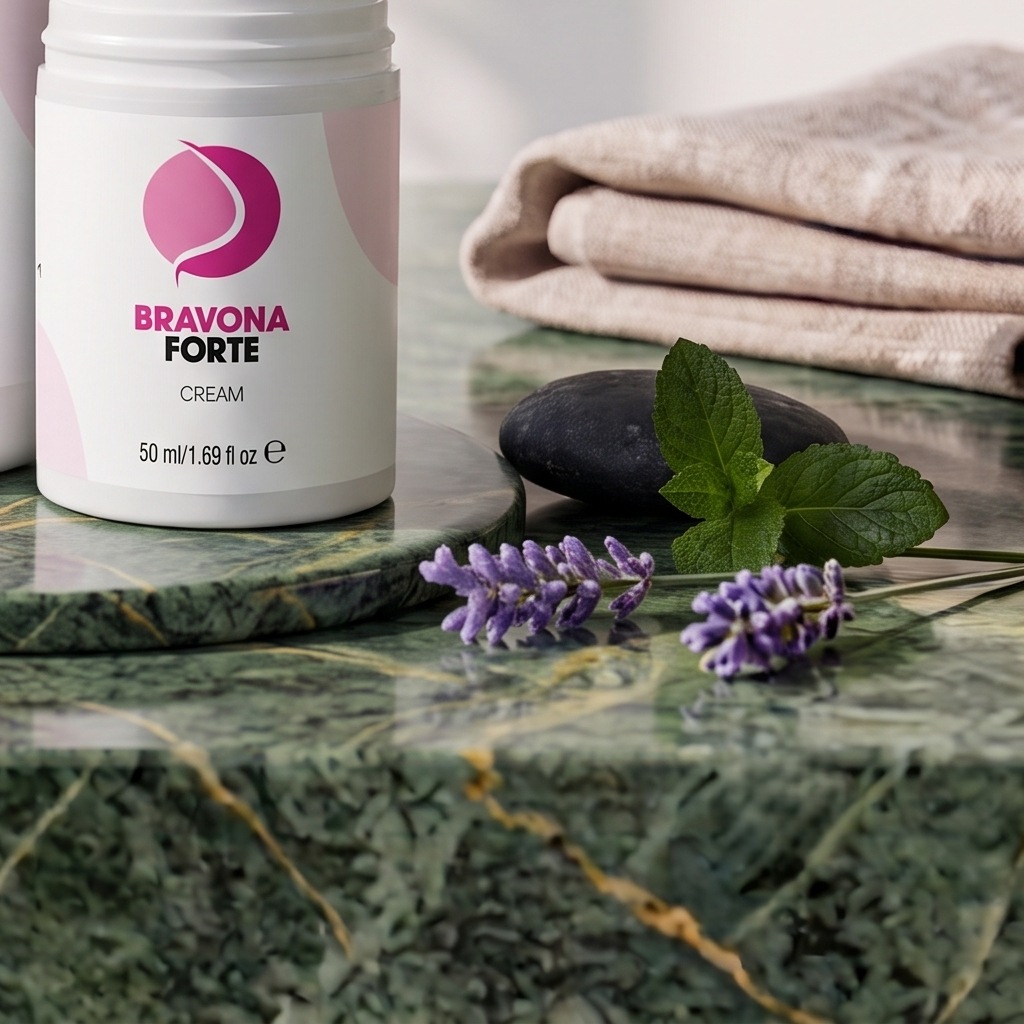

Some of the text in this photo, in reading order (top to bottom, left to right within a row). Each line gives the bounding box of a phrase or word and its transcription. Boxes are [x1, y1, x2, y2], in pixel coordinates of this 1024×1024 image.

[134, 304, 290, 333] BRAVONA
[165, 335, 260, 364] FORTE
[180, 385, 245, 403] CREAM
[139, 442, 159, 463] 50
[163, 444, 222, 466] ml/1.69
[225, 444, 235, 466] fl
[240, 448, 258, 466] oz
